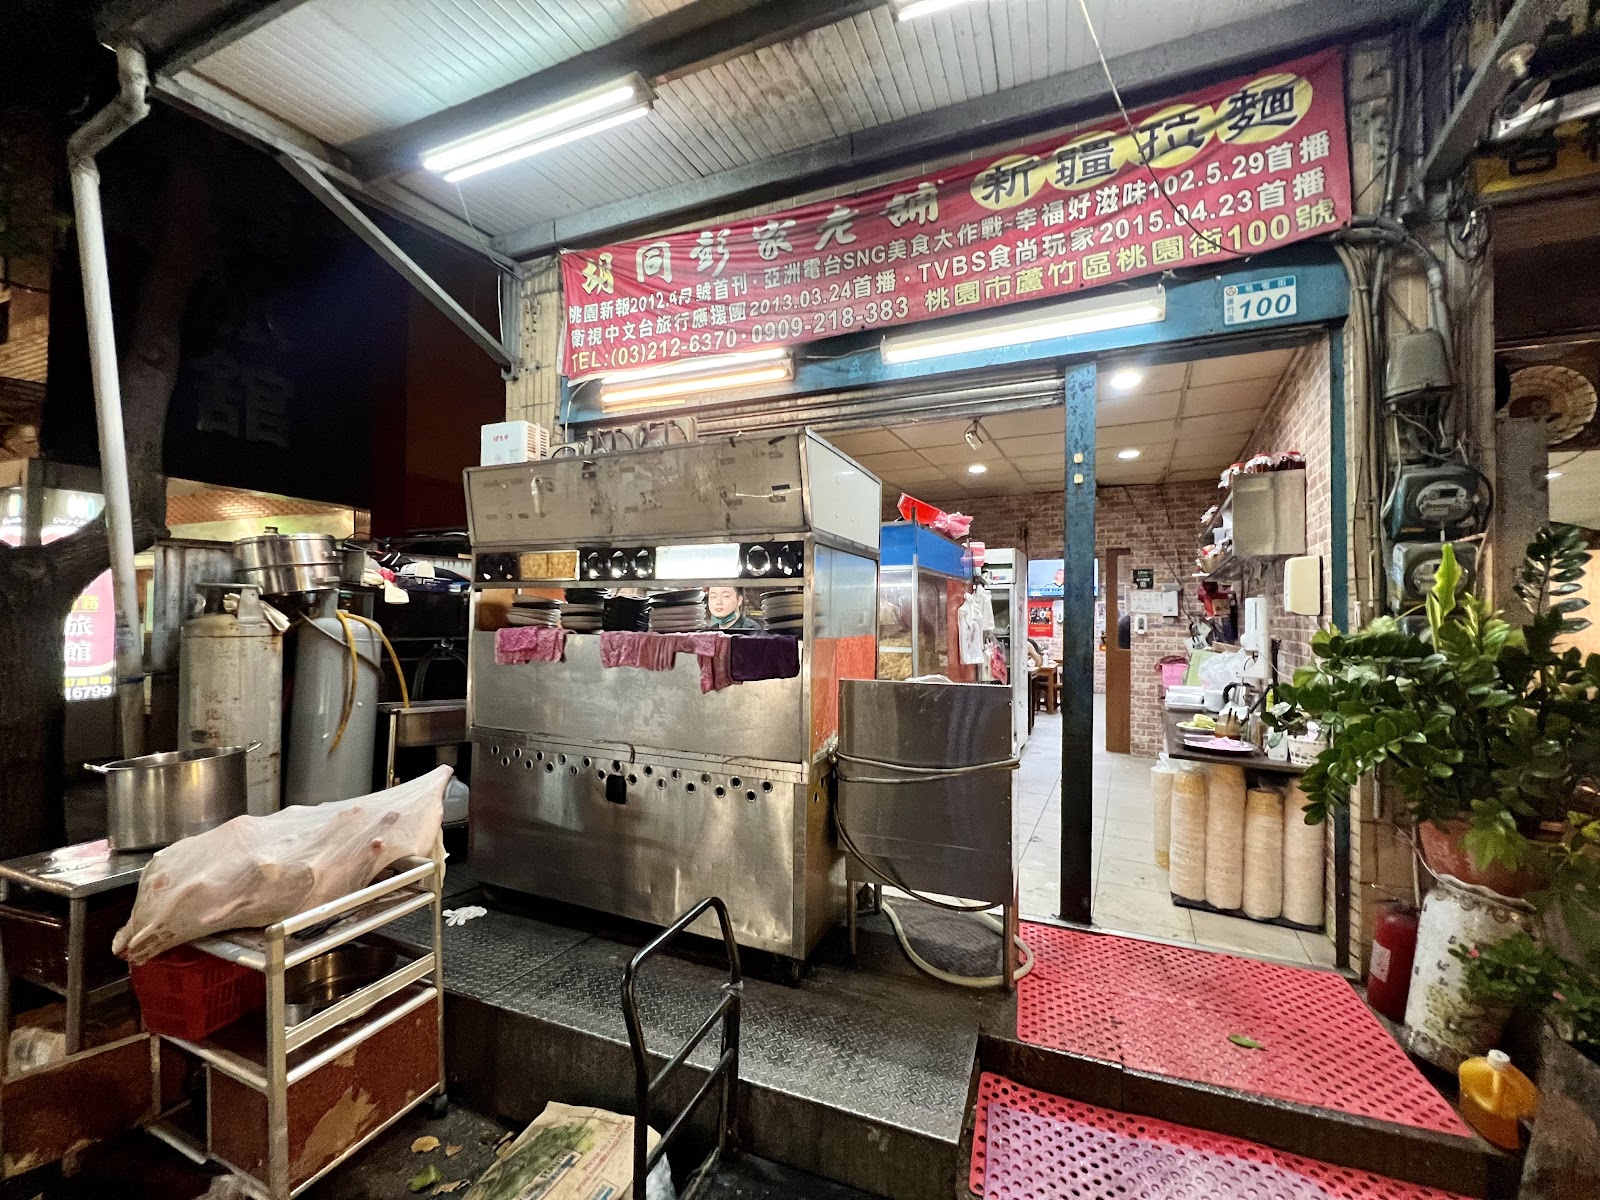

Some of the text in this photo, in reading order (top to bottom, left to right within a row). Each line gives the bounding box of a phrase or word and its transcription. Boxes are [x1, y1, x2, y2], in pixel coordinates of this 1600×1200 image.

[981, 85, 1298, 204] 新疆拉麵
[924, 198, 1337, 312] 桃園市蘆竹區桃園街100號
[1240, 294, 1291, 319] 100
